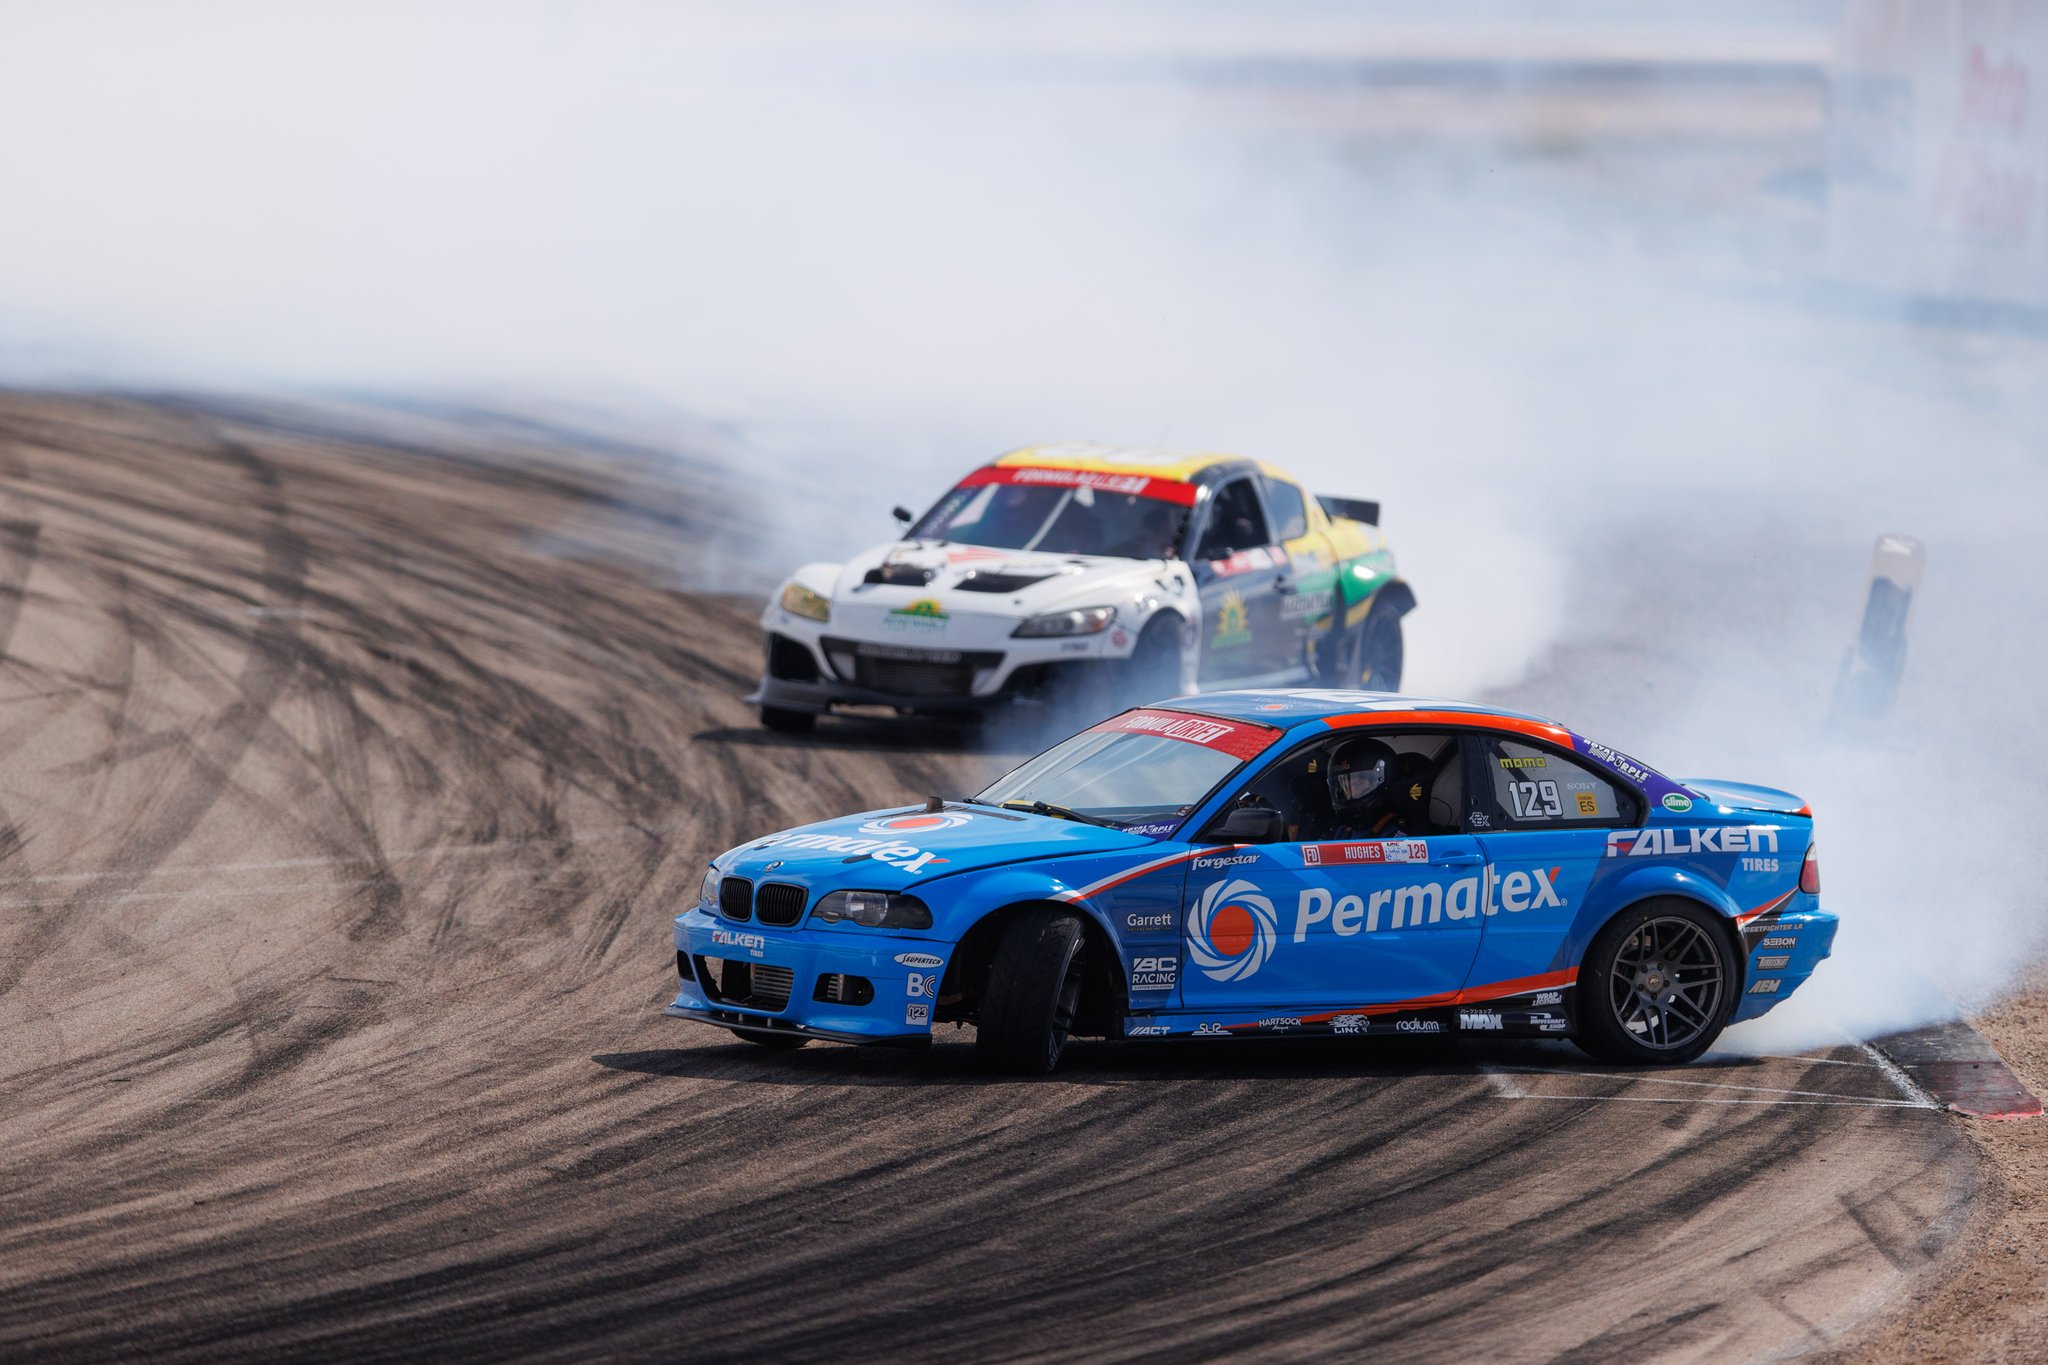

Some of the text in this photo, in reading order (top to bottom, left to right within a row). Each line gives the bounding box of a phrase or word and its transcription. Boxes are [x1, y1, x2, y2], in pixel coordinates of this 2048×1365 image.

[1119, 715, 1231, 742] FORMULA DRIFT
[1606, 755, 1649, 781] PURPLE
[1567, 783, 1597, 791] SONY
[1508, 780, 1564, 818] 129
[1665, 796, 1689, 807] slime
[1580, 801, 1595, 812] ES
[1607, 826, 1778, 857] FALKEN
[1307, 848, 1318, 861] FD
[1344, 845, 1380, 859] HUGHES
[1407, 844, 1427, 859] 129
[1192, 853, 1261, 871] forgestar
[1742, 858, 1779, 872] TIRES
[1294, 863, 1562, 943] Permatex
[1127, 914, 1172, 927] Garrett
[712, 930, 764, 949] FALKEN
[750, 949, 764, 958] TIRES
[903, 955, 942, 965] SUPERTECH
[1132, 973, 1176, 984] RACING
[1747, 979, 1781, 993] AEM
[1536, 991, 1559, 1001] WRAP
[1258, 1018, 1302, 1028] HARTSOCK
[1396, 1017, 1440, 1031] radium
[1460, 1014, 1503, 1030] MAX
